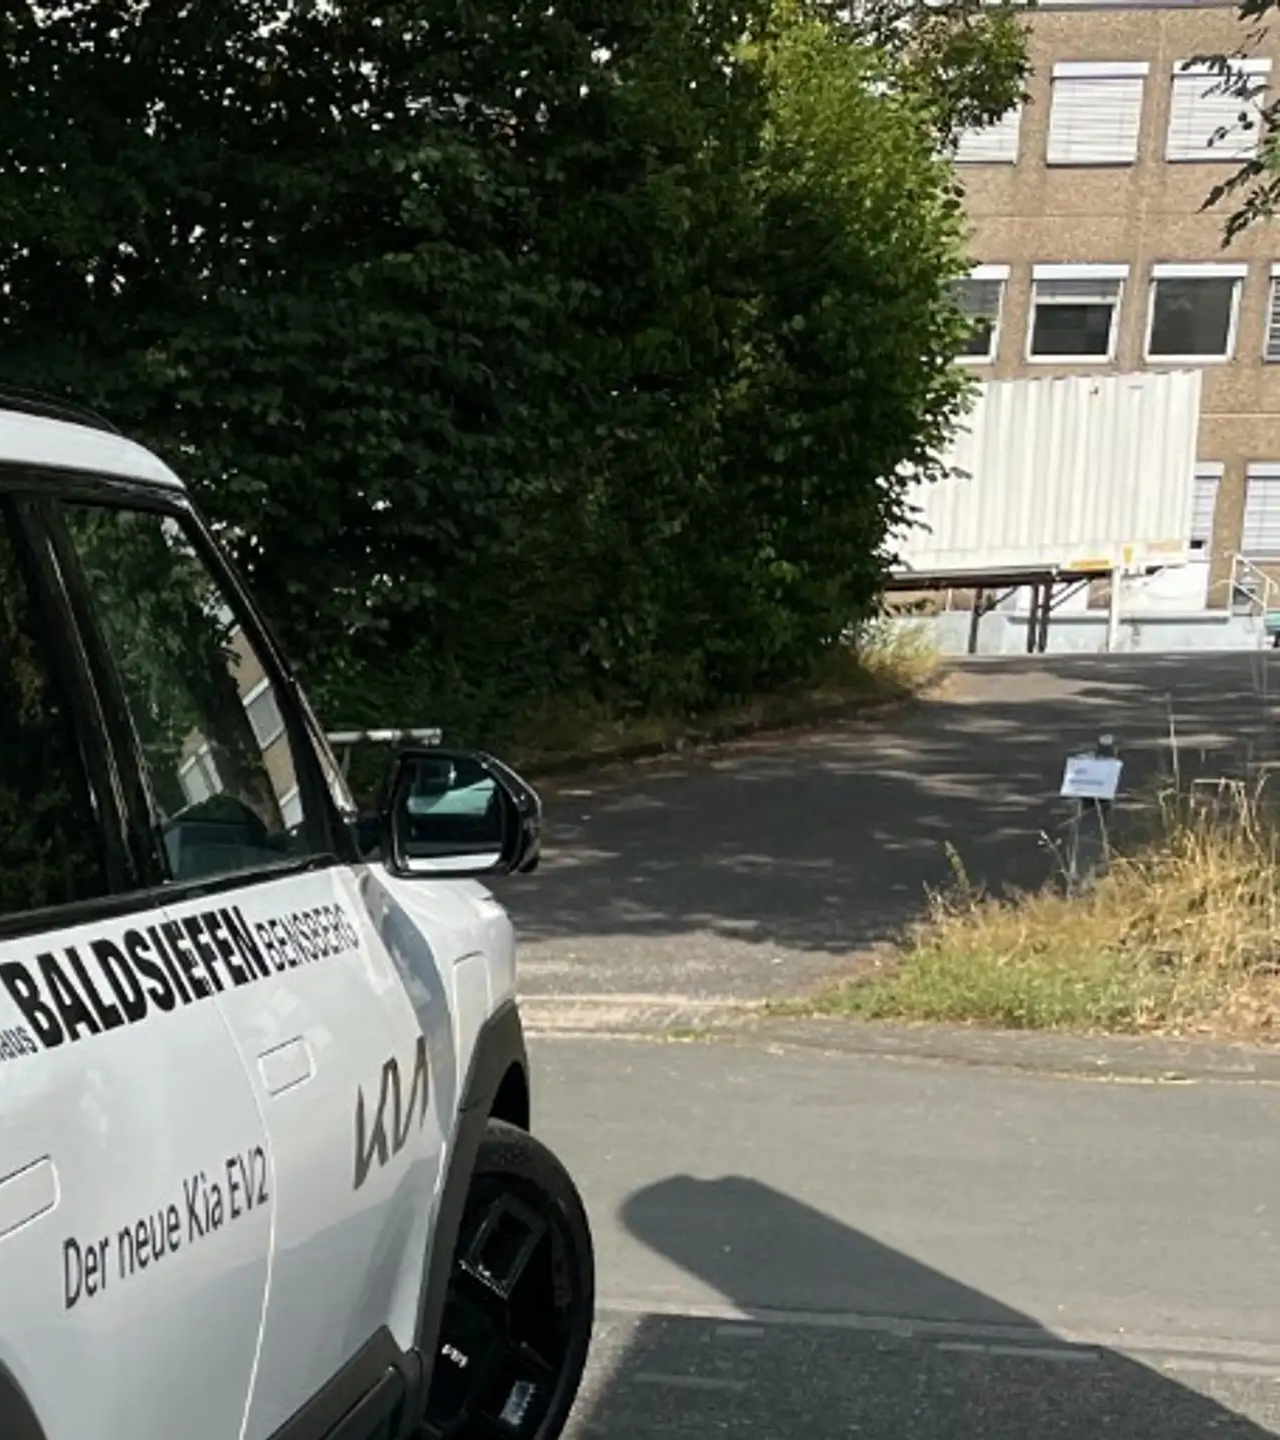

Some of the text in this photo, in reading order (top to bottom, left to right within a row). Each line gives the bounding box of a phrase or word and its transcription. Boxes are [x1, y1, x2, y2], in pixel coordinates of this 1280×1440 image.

[254, 903, 359, 972] BENSBERG
[352, 1034, 431, 1191] KIA
[62, 1145, 270, 1310] Der neue Kia EV2
